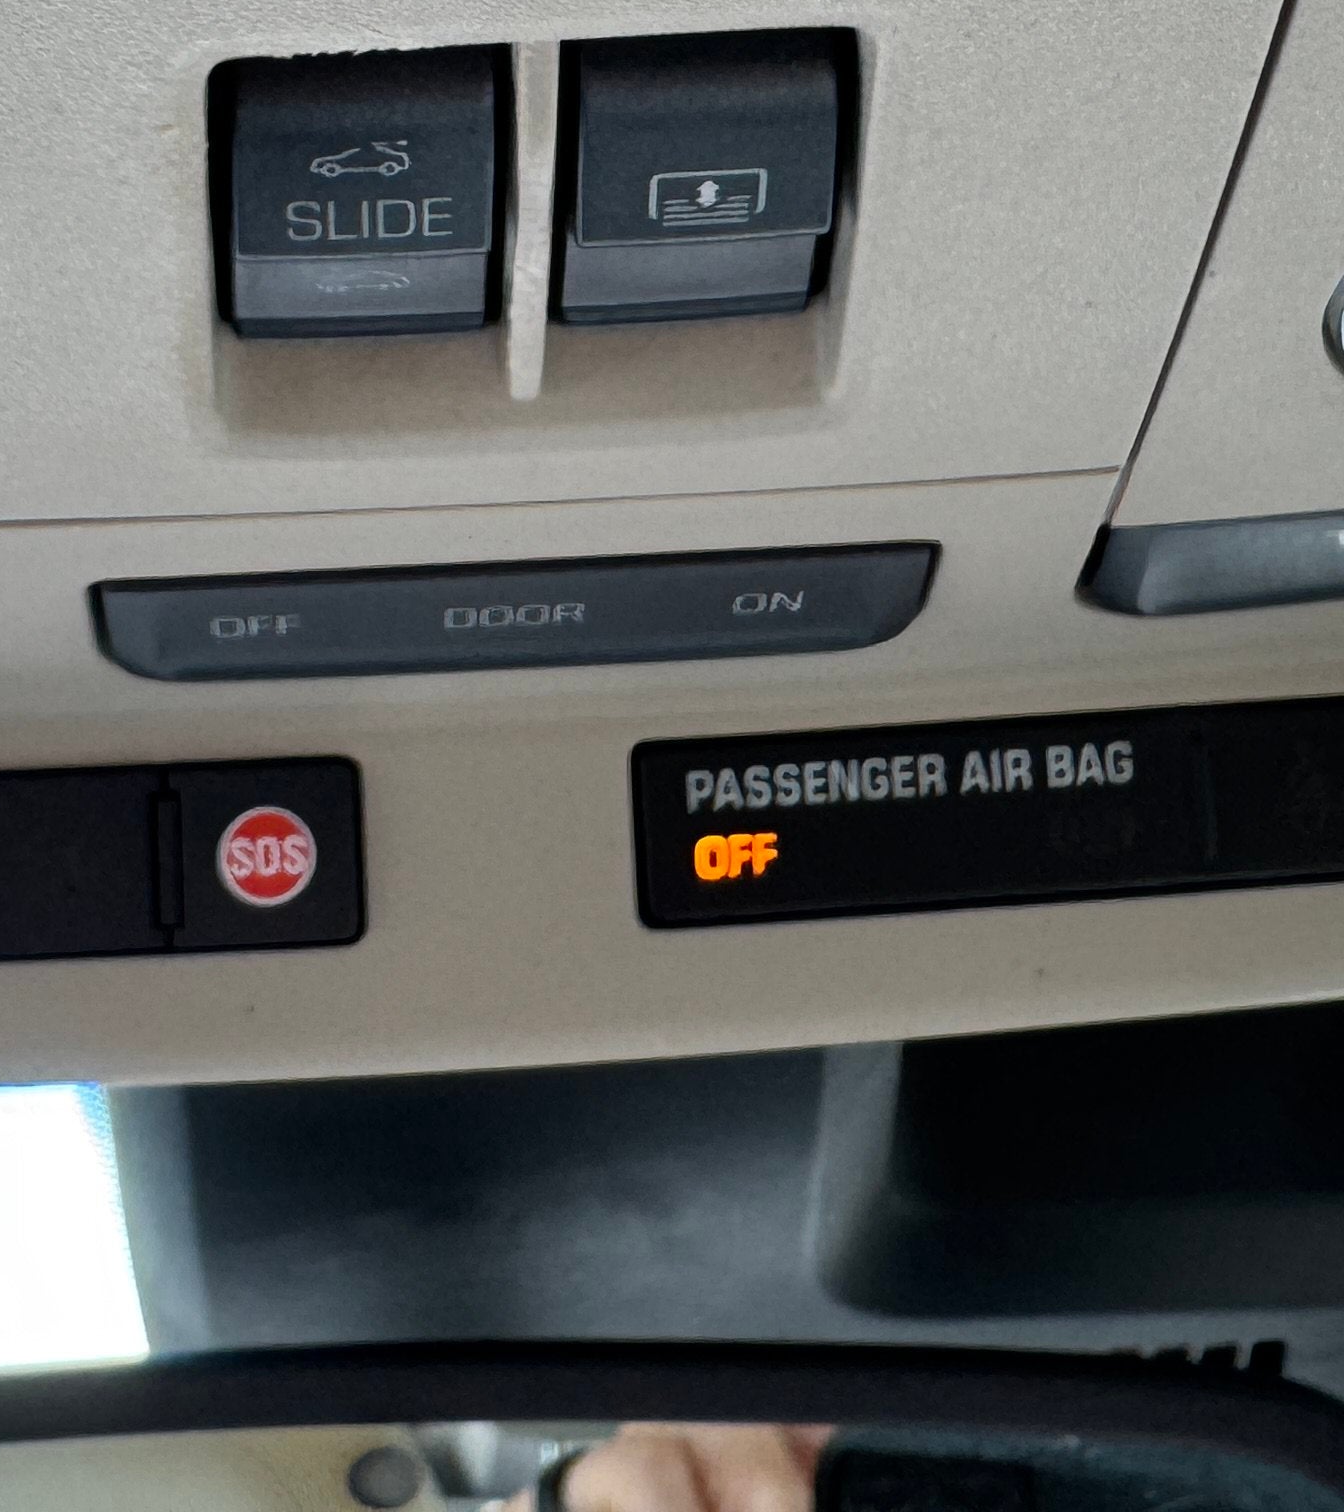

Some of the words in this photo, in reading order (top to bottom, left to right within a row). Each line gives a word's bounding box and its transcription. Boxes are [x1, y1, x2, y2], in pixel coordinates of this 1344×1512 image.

[285, 197, 453, 241] SLIDE
[444, 602, 584, 630] DOOR
[732, 589, 805, 616] ON
[210, 613, 300, 638] OFF
[687, 752, 948, 813] PASSENGER
[960, 747, 1033, 793] AIR
[1046, 740, 1134, 788] BAG
[230, 836, 306, 878] SOS
[694, 832, 778, 881] OFF
